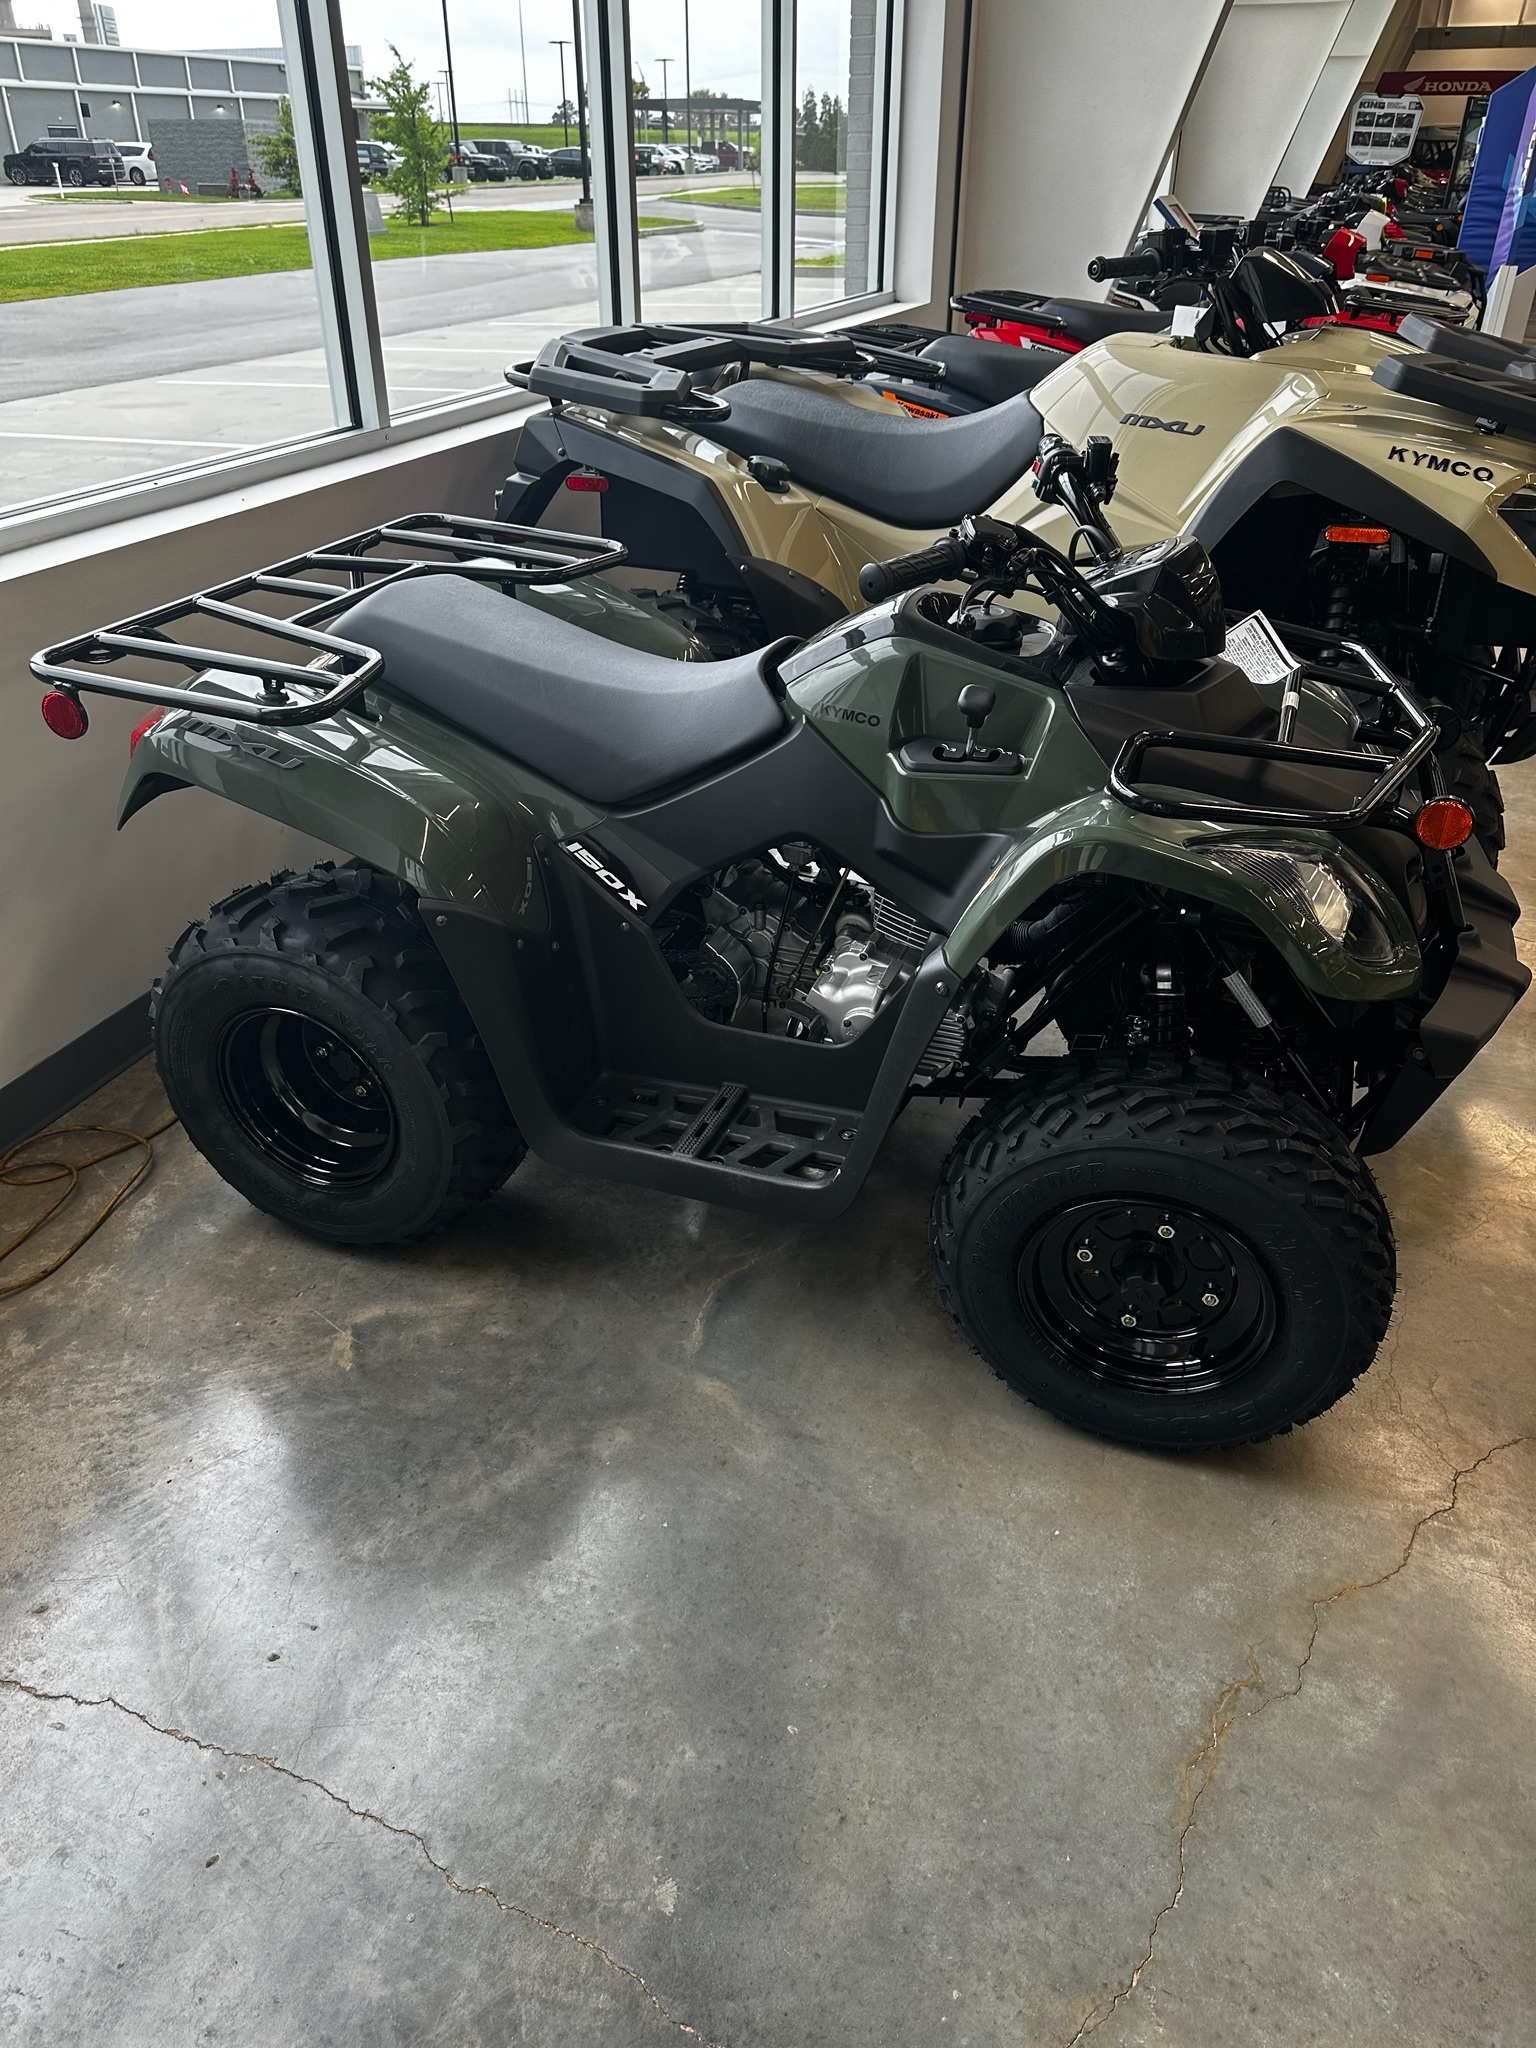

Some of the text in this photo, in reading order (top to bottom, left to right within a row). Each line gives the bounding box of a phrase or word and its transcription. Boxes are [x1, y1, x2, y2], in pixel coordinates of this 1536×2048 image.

[1423, 81, 1492, 92] HONDA
[1119, 413, 1206, 436] MXU
[1388, 445, 1495, 482] KYMCO
[820, 702, 881, 728] KYMCO
[566, 841, 648, 911] 150X
[970, 1161, 1108, 1269] PATHFINDER
